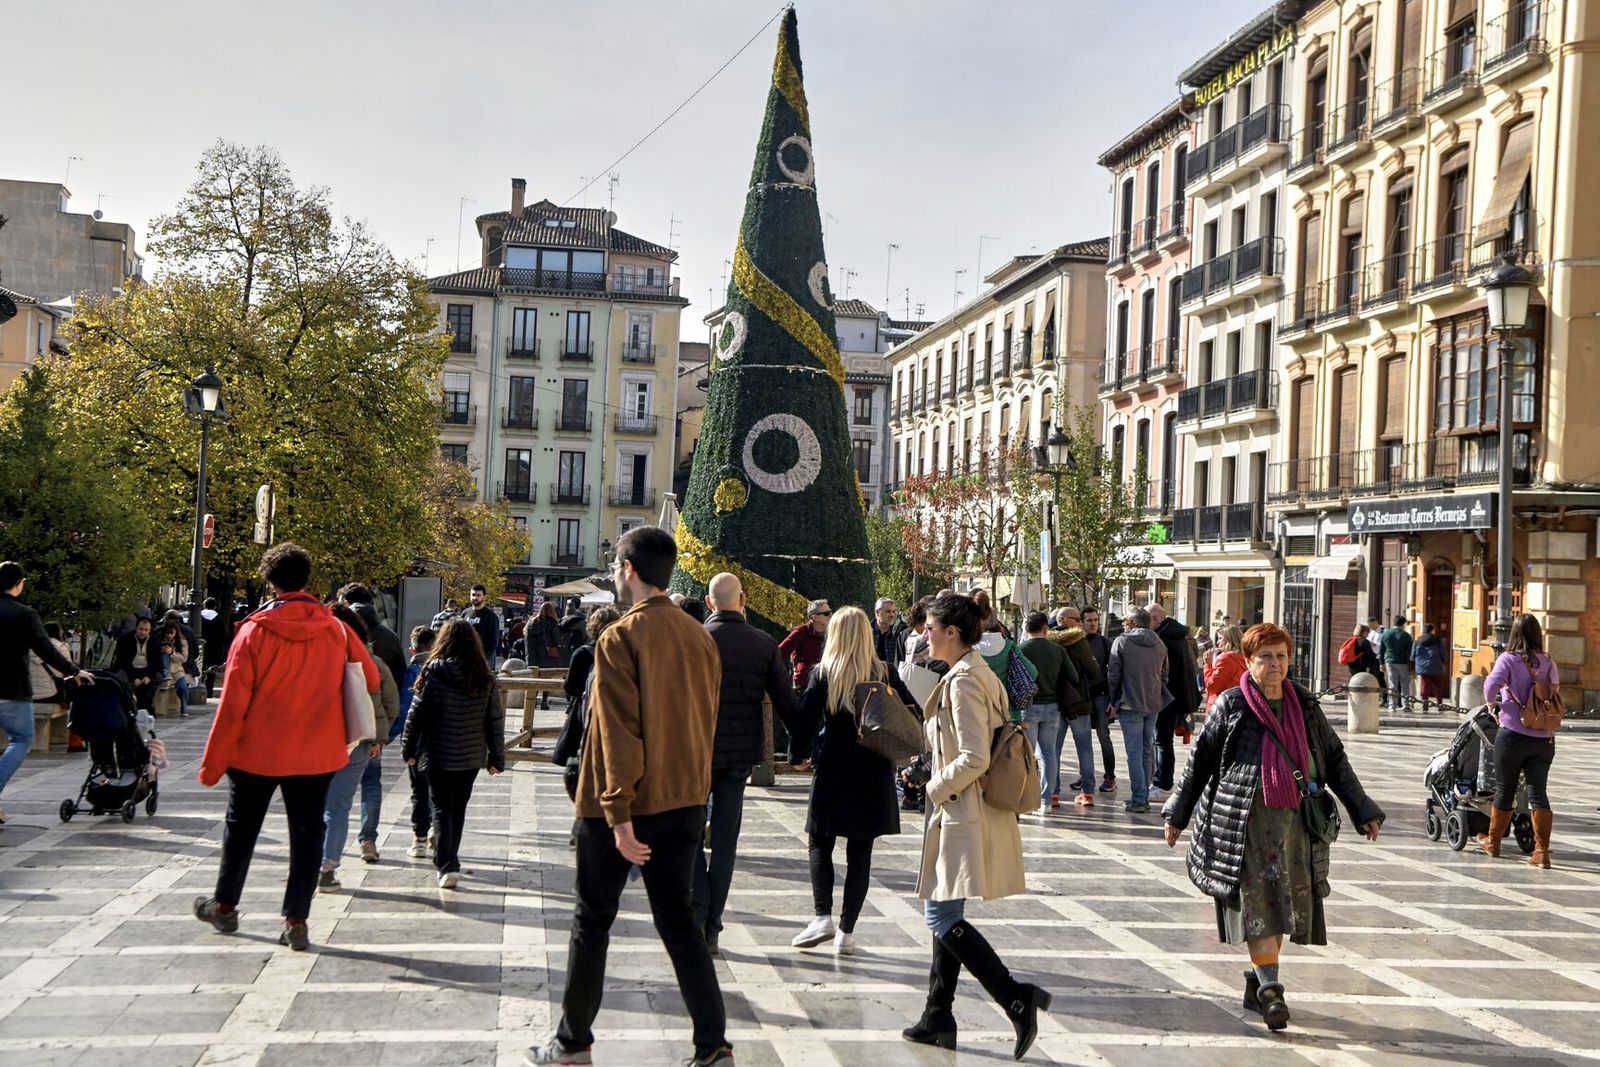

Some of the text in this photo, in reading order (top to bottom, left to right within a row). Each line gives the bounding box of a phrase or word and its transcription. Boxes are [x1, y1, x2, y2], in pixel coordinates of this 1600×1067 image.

[1194, 73, 1225, 107] HOTEL
[1257, 28, 1294, 67] PLAZA
[1375, 505, 1467, 526] Restaurante Torres Bermejas
